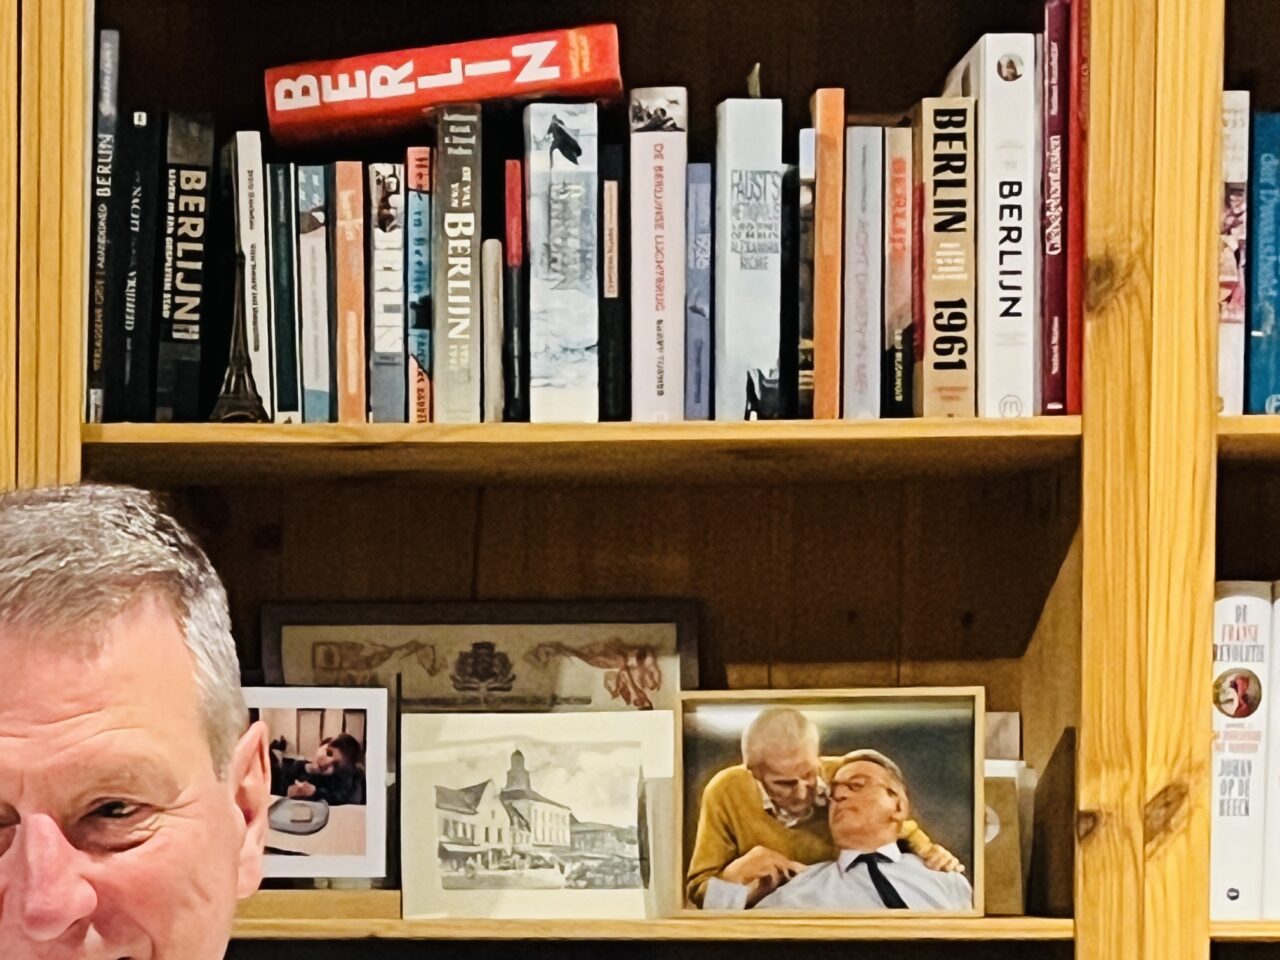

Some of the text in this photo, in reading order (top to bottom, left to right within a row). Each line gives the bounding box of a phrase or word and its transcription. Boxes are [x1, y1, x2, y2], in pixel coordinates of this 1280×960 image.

[274, 40, 560, 112] BERLIN
[95, 133, 115, 197] BERLIN
[173, 169, 207, 322] BERLIJN
[932, 107, 969, 372] BERLIN 1961
[999, 181, 1024, 319] BERLIJN
